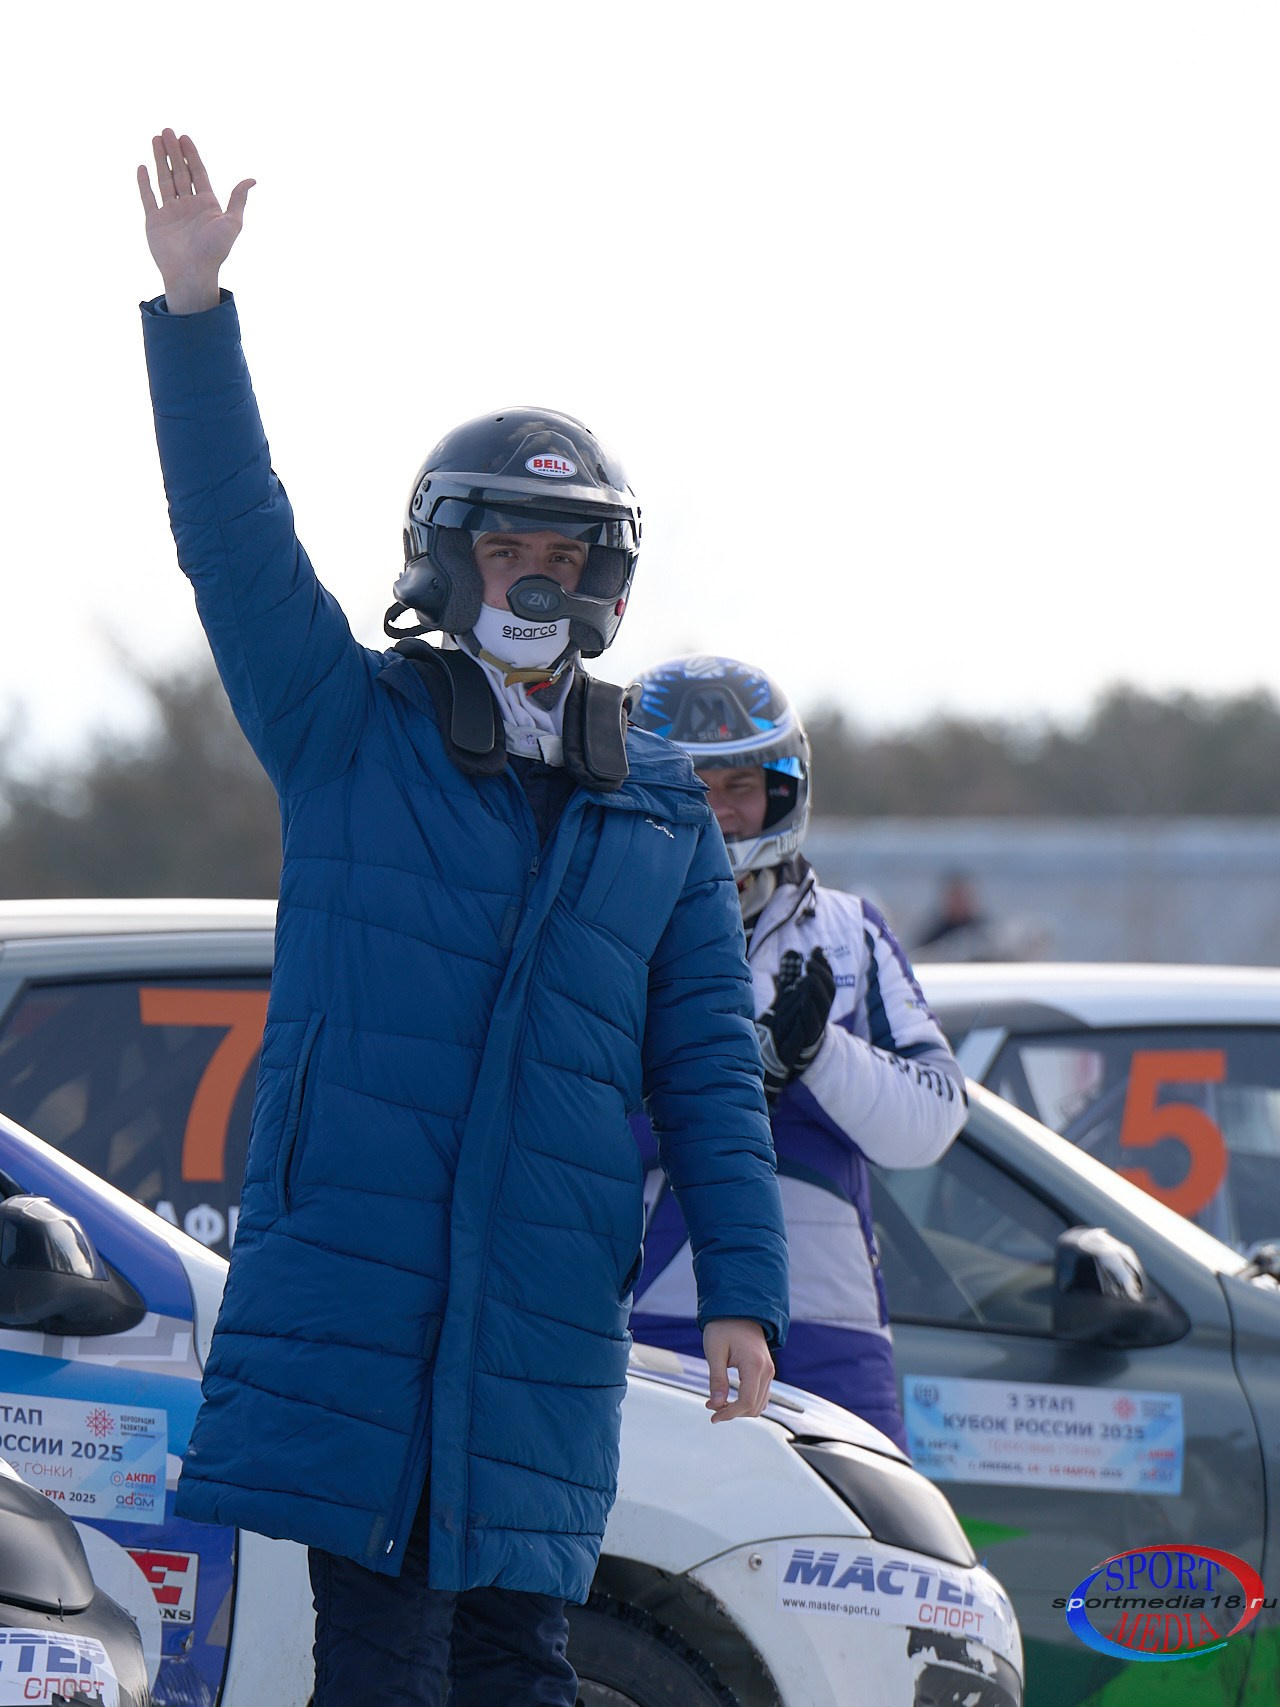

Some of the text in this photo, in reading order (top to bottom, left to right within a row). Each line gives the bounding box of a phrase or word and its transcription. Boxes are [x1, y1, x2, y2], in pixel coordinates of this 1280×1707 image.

[533, 459, 570, 472] BELL
[502, 623, 558, 640] sparco
[139, 988, 270, 1182] 7
[1118, 1050, 1228, 1218] 5
[1026, 1394, 1075, 1413] ЭТАП
[943, 1413, 1145, 1440] КУБОК РОССИИ 2025
[71, 1440, 124, 1462] 2025
[24, 1462, 72, 1478] ГОНКИ
[125, 1472, 156, 1484] АКПП
[69, 1491, 97, 1504] 2025
[782, 1598, 880, 1616] www.master-sport.ru
[918, 1603, 984, 1632] СПОРТ
